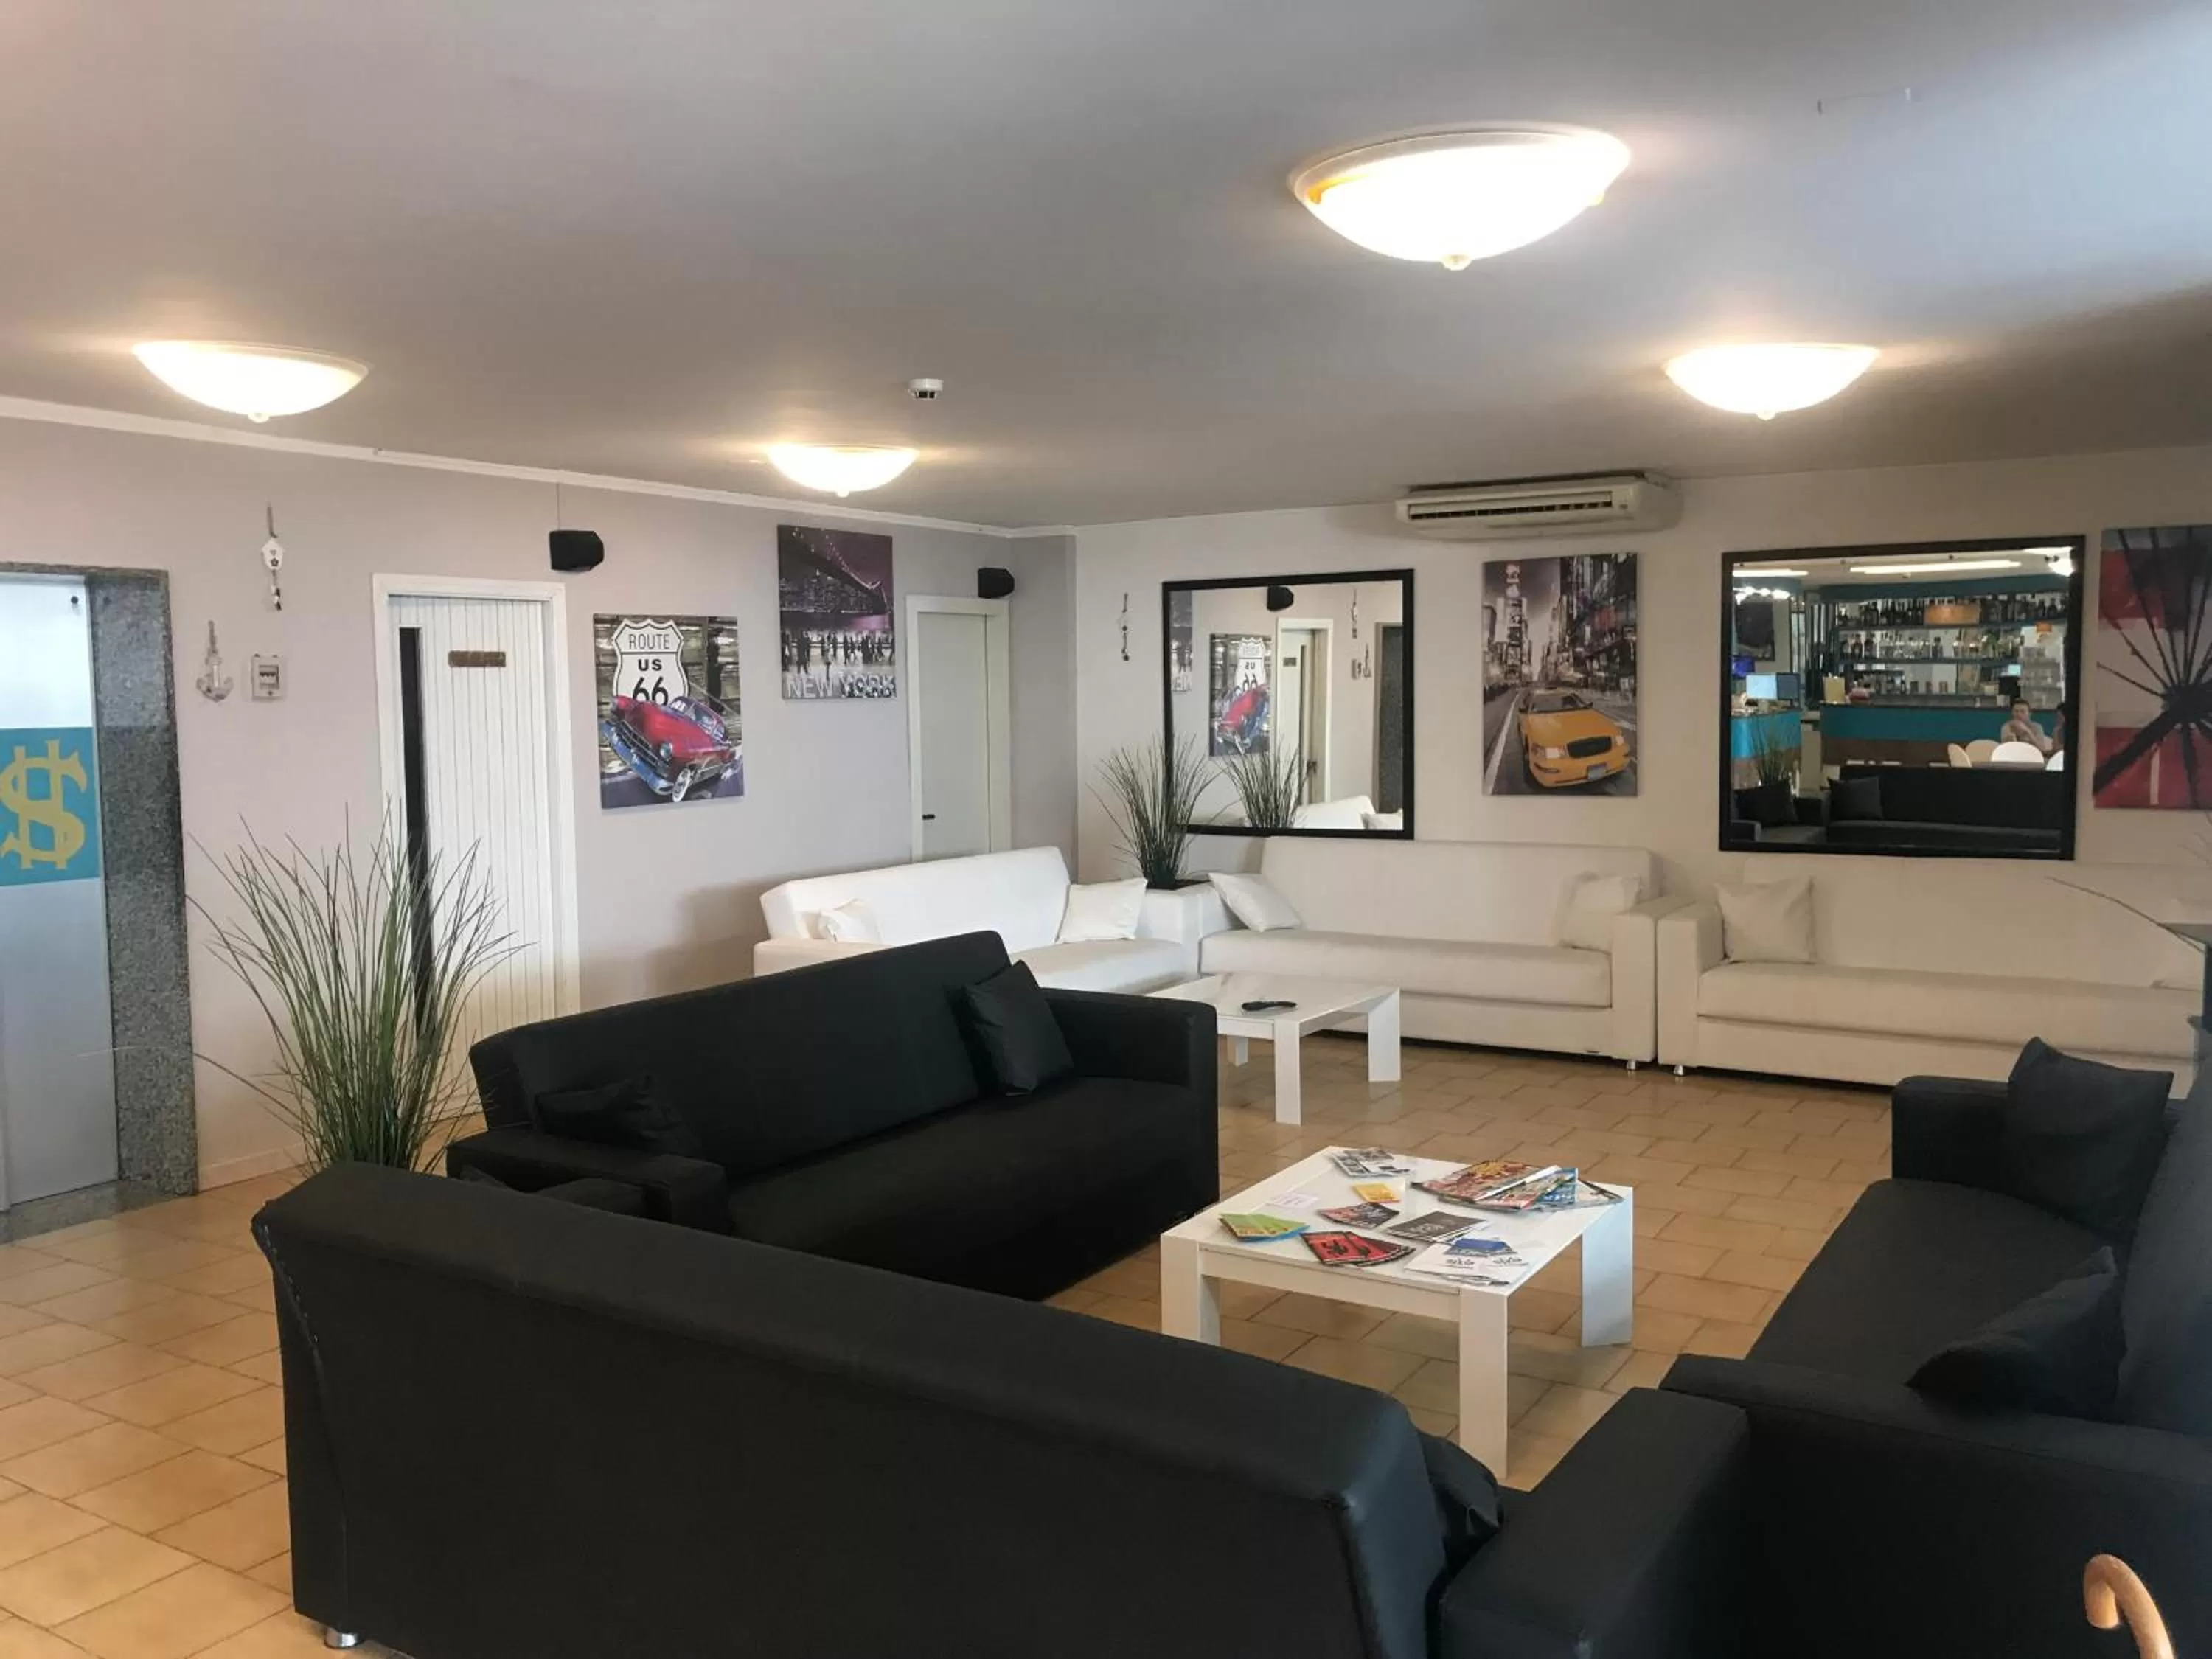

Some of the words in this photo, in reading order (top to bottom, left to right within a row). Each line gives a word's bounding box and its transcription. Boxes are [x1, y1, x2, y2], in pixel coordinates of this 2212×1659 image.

[628, 633, 670, 650] ROUTE
[638, 658, 663, 672] US
[632, 676, 669, 706] 66
[787, 674, 832, 698] NEW
[838, 672, 896, 698] YORK
